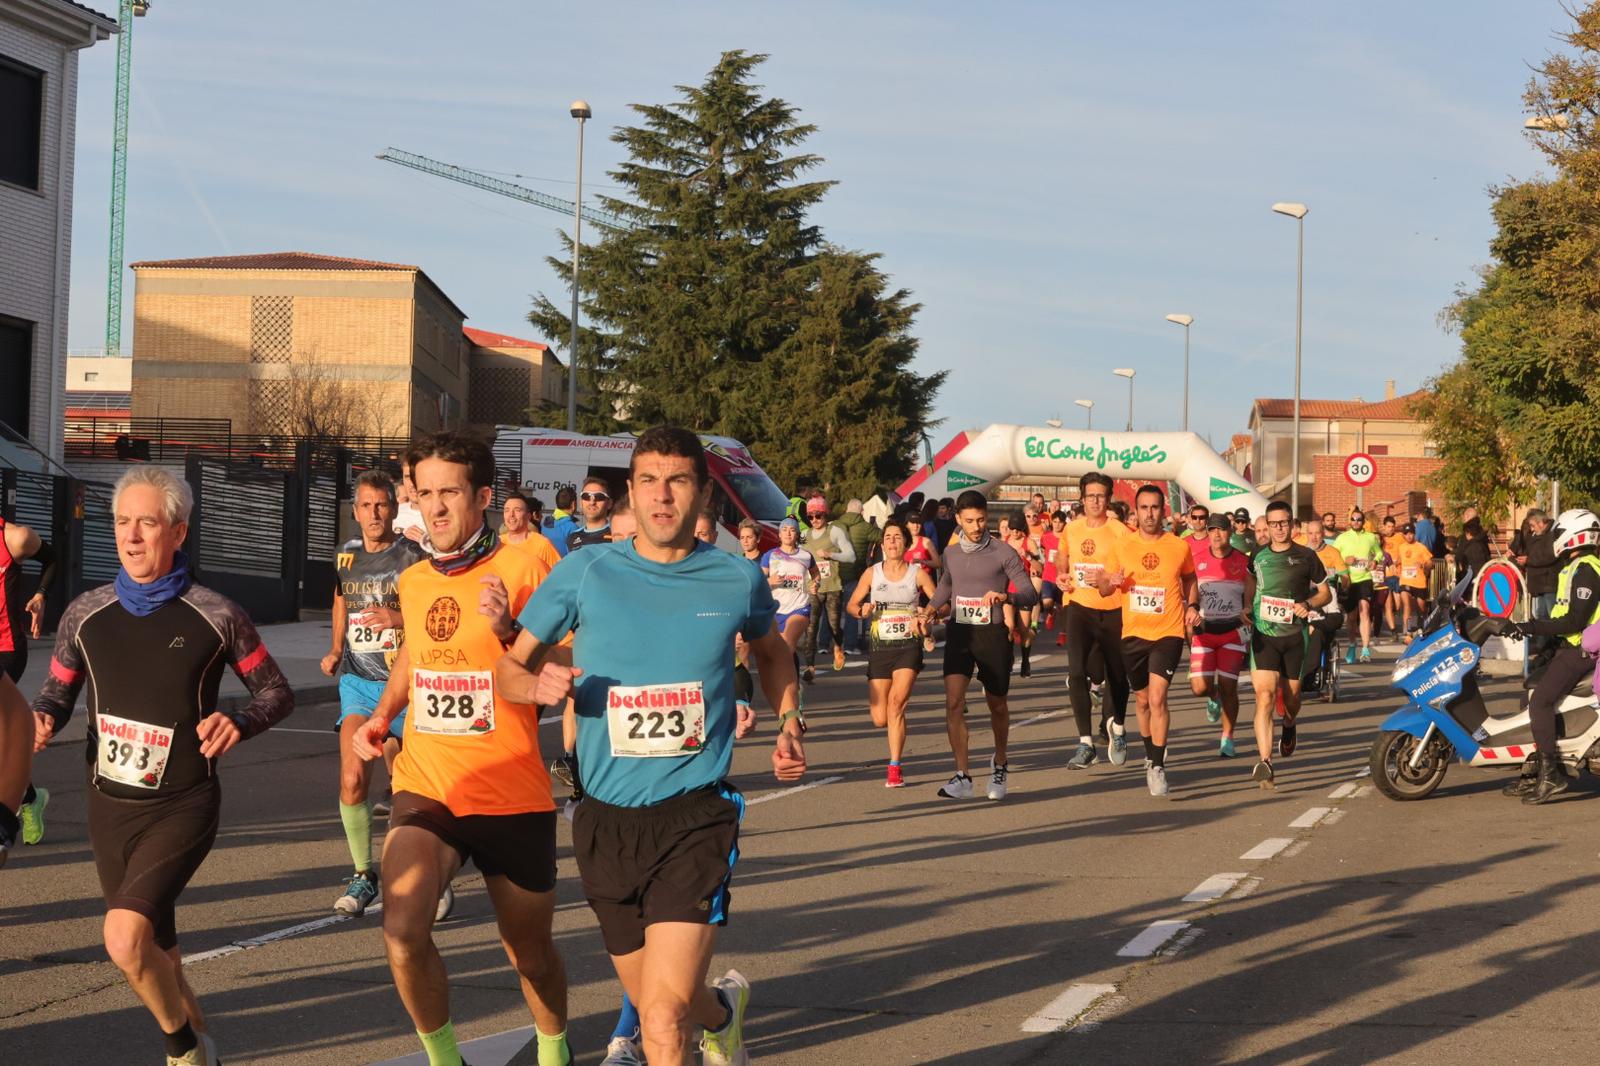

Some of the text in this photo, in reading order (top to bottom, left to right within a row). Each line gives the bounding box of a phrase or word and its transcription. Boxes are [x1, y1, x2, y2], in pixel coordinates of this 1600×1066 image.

[568, 440, 633, 449] AMBULANCIA
[1024, 436, 1167, 469] El Corte Inglés
[1351, 464, 1369, 475] 30
[525, 480, 577, 490] Cruz Roja
[783, 580, 798, 588] 222
[1137, 596, 1157, 607] 136
[962, 607, 983, 617] 194
[1267, 605, 1286, 617] 193
[885, 623, 906, 633] 258
[354, 628, 384, 642] 287
[420, 648, 469, 665] UPSA
[1431, 656, 1455, 676] 112
[416, 672, 490, 691] bedunia
[609, 688, 701, 709] bedunia
[427, 694, 474, 718] 328
[627, 710, 685, 739] 223
